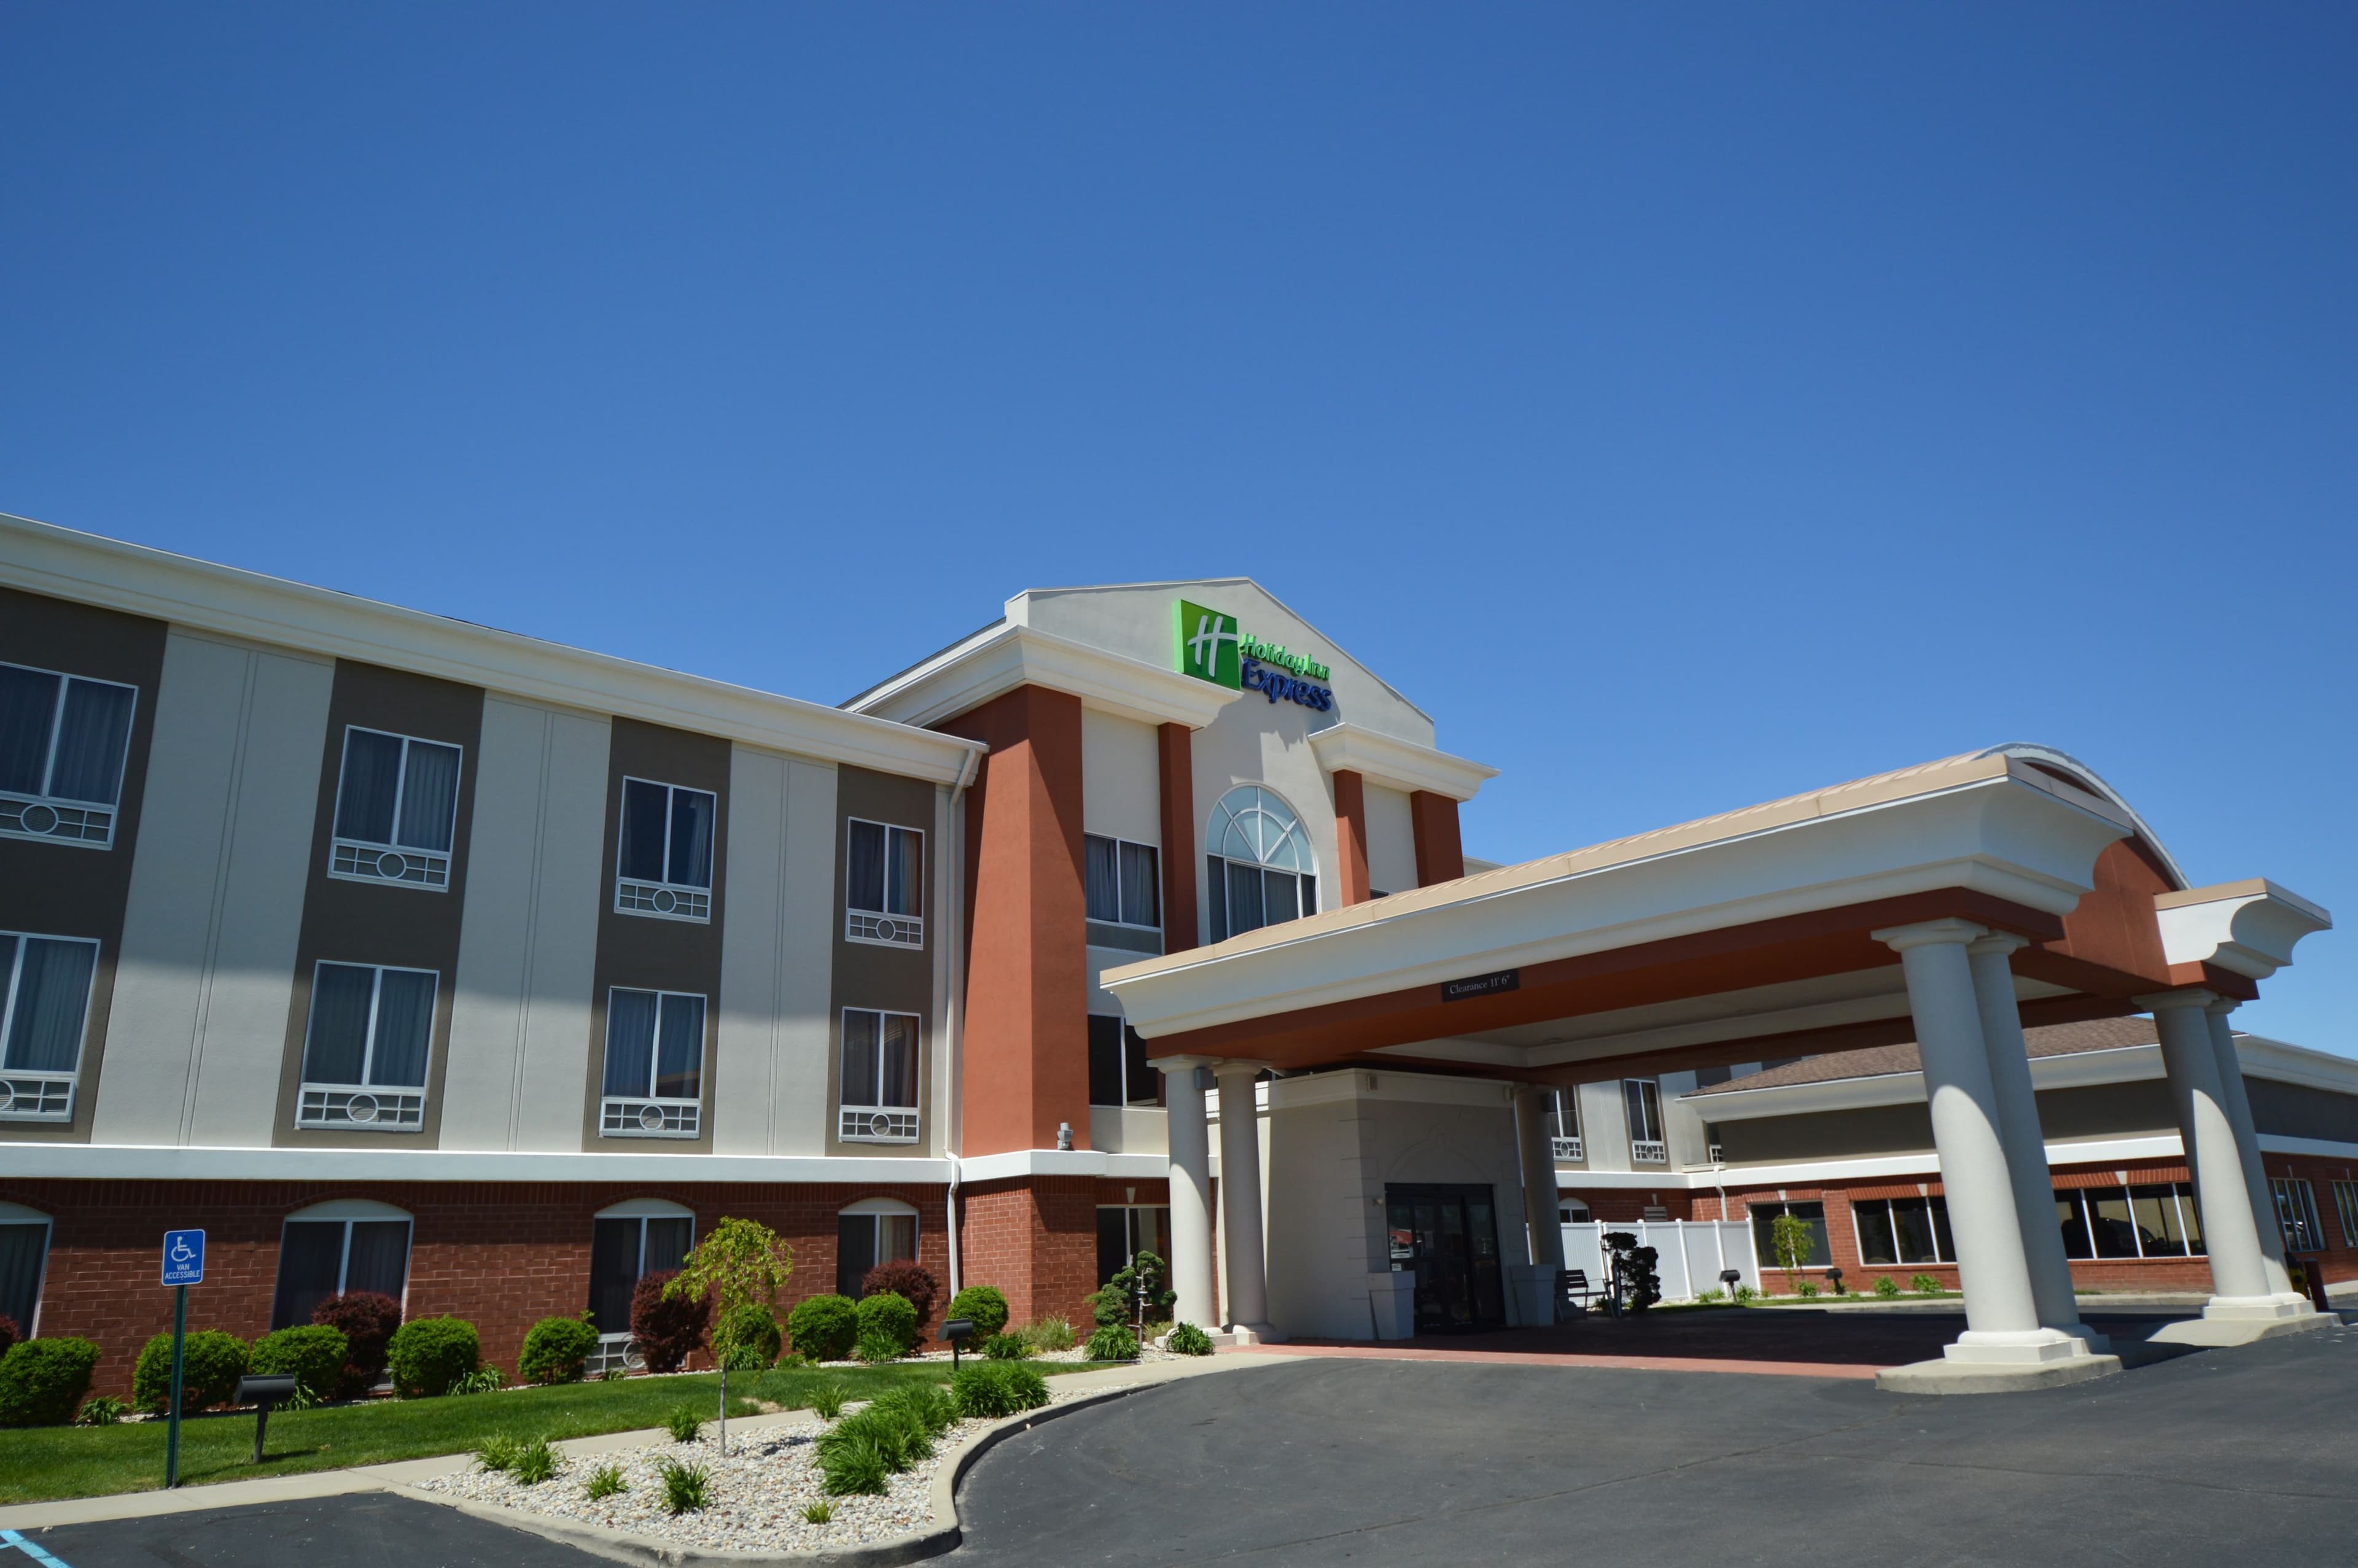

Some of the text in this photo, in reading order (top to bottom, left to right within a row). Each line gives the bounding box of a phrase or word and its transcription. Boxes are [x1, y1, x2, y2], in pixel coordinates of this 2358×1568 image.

[1188, 615, 1237, 677] H
[1240, 634, 1331, 681] Holiday Inn
[1242, 658, 1332, 712] Express
[1450, 982, 1487, 994] Clearance
[165, 1270, 200, 1279] ACCESSIBLE
